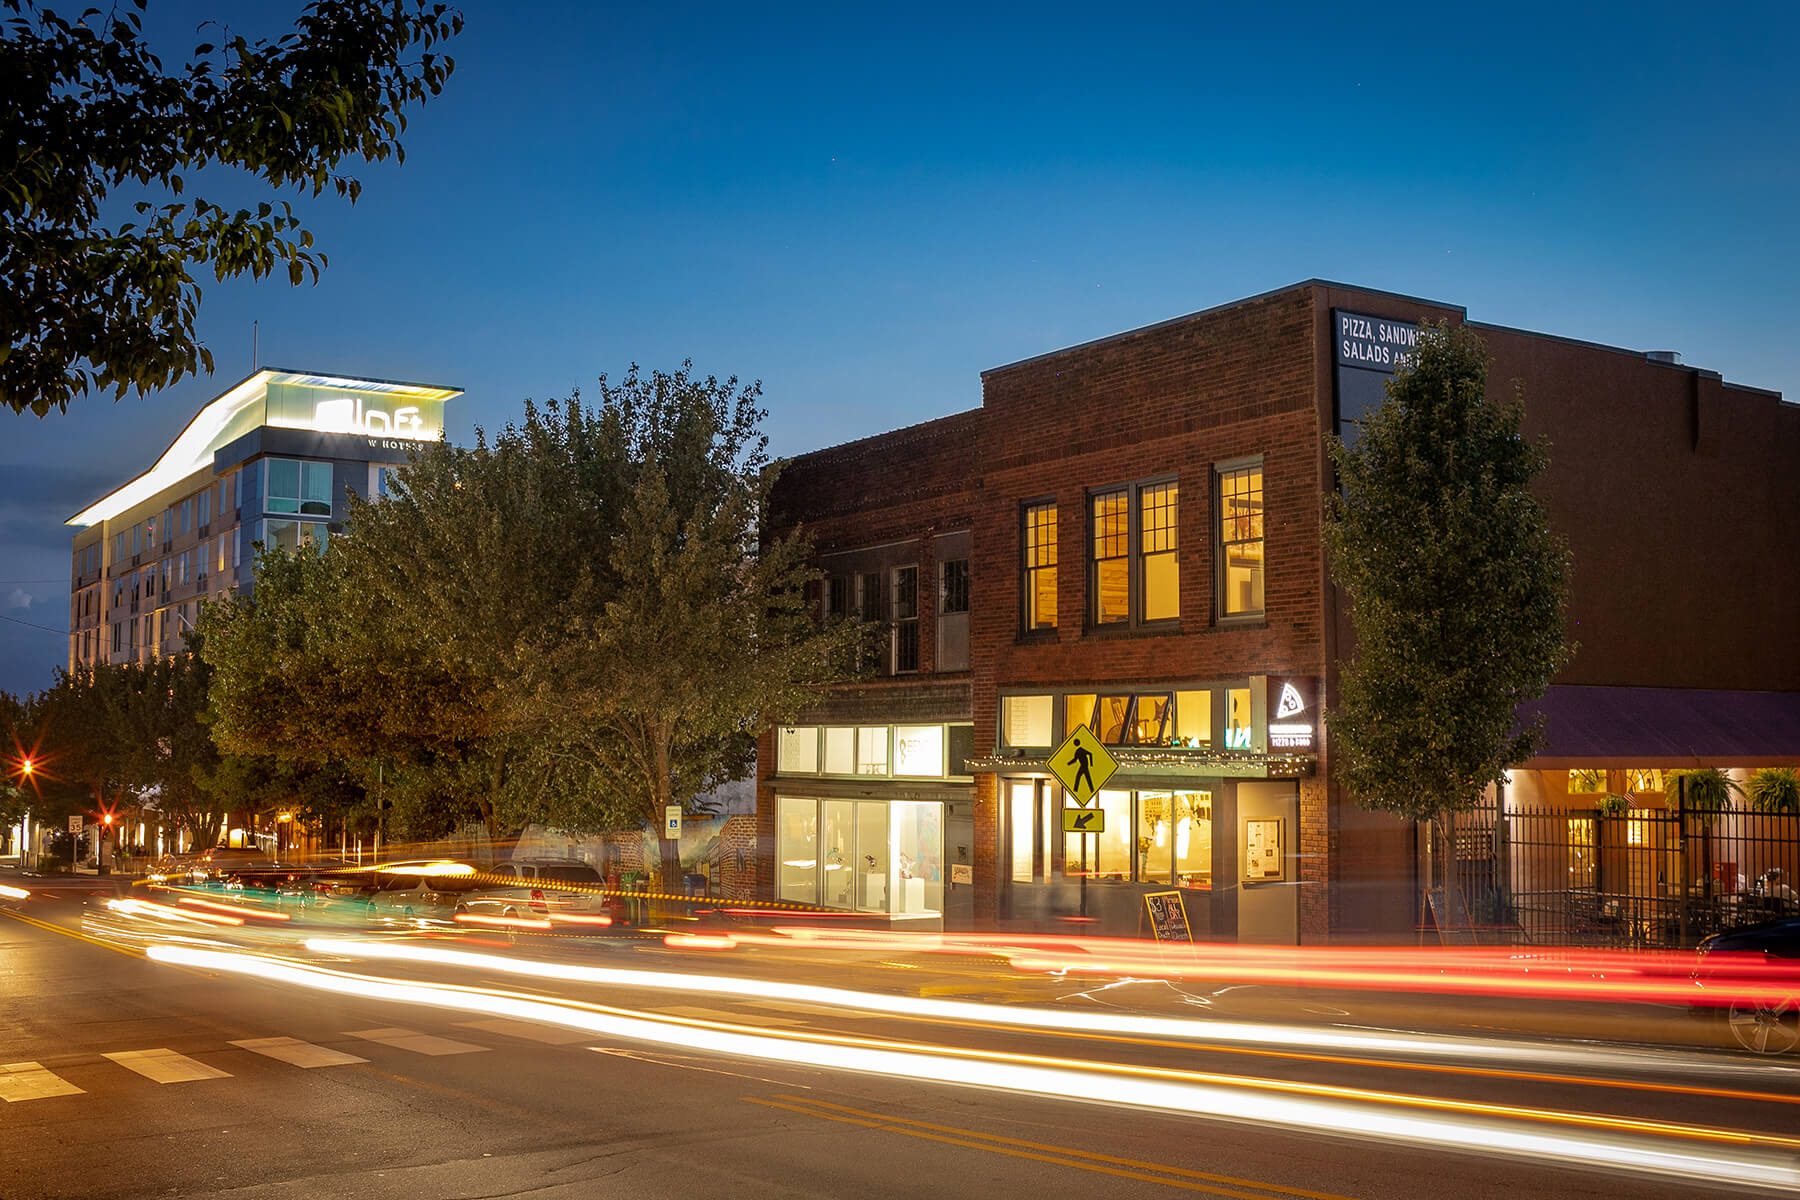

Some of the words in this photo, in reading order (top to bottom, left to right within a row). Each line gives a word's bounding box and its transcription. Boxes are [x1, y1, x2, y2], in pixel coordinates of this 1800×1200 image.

[1342, 317, 1376, 343] PIZZA,
[1343, 340, 1390, 364] SALADS
[368, 439, 377, 448] W
